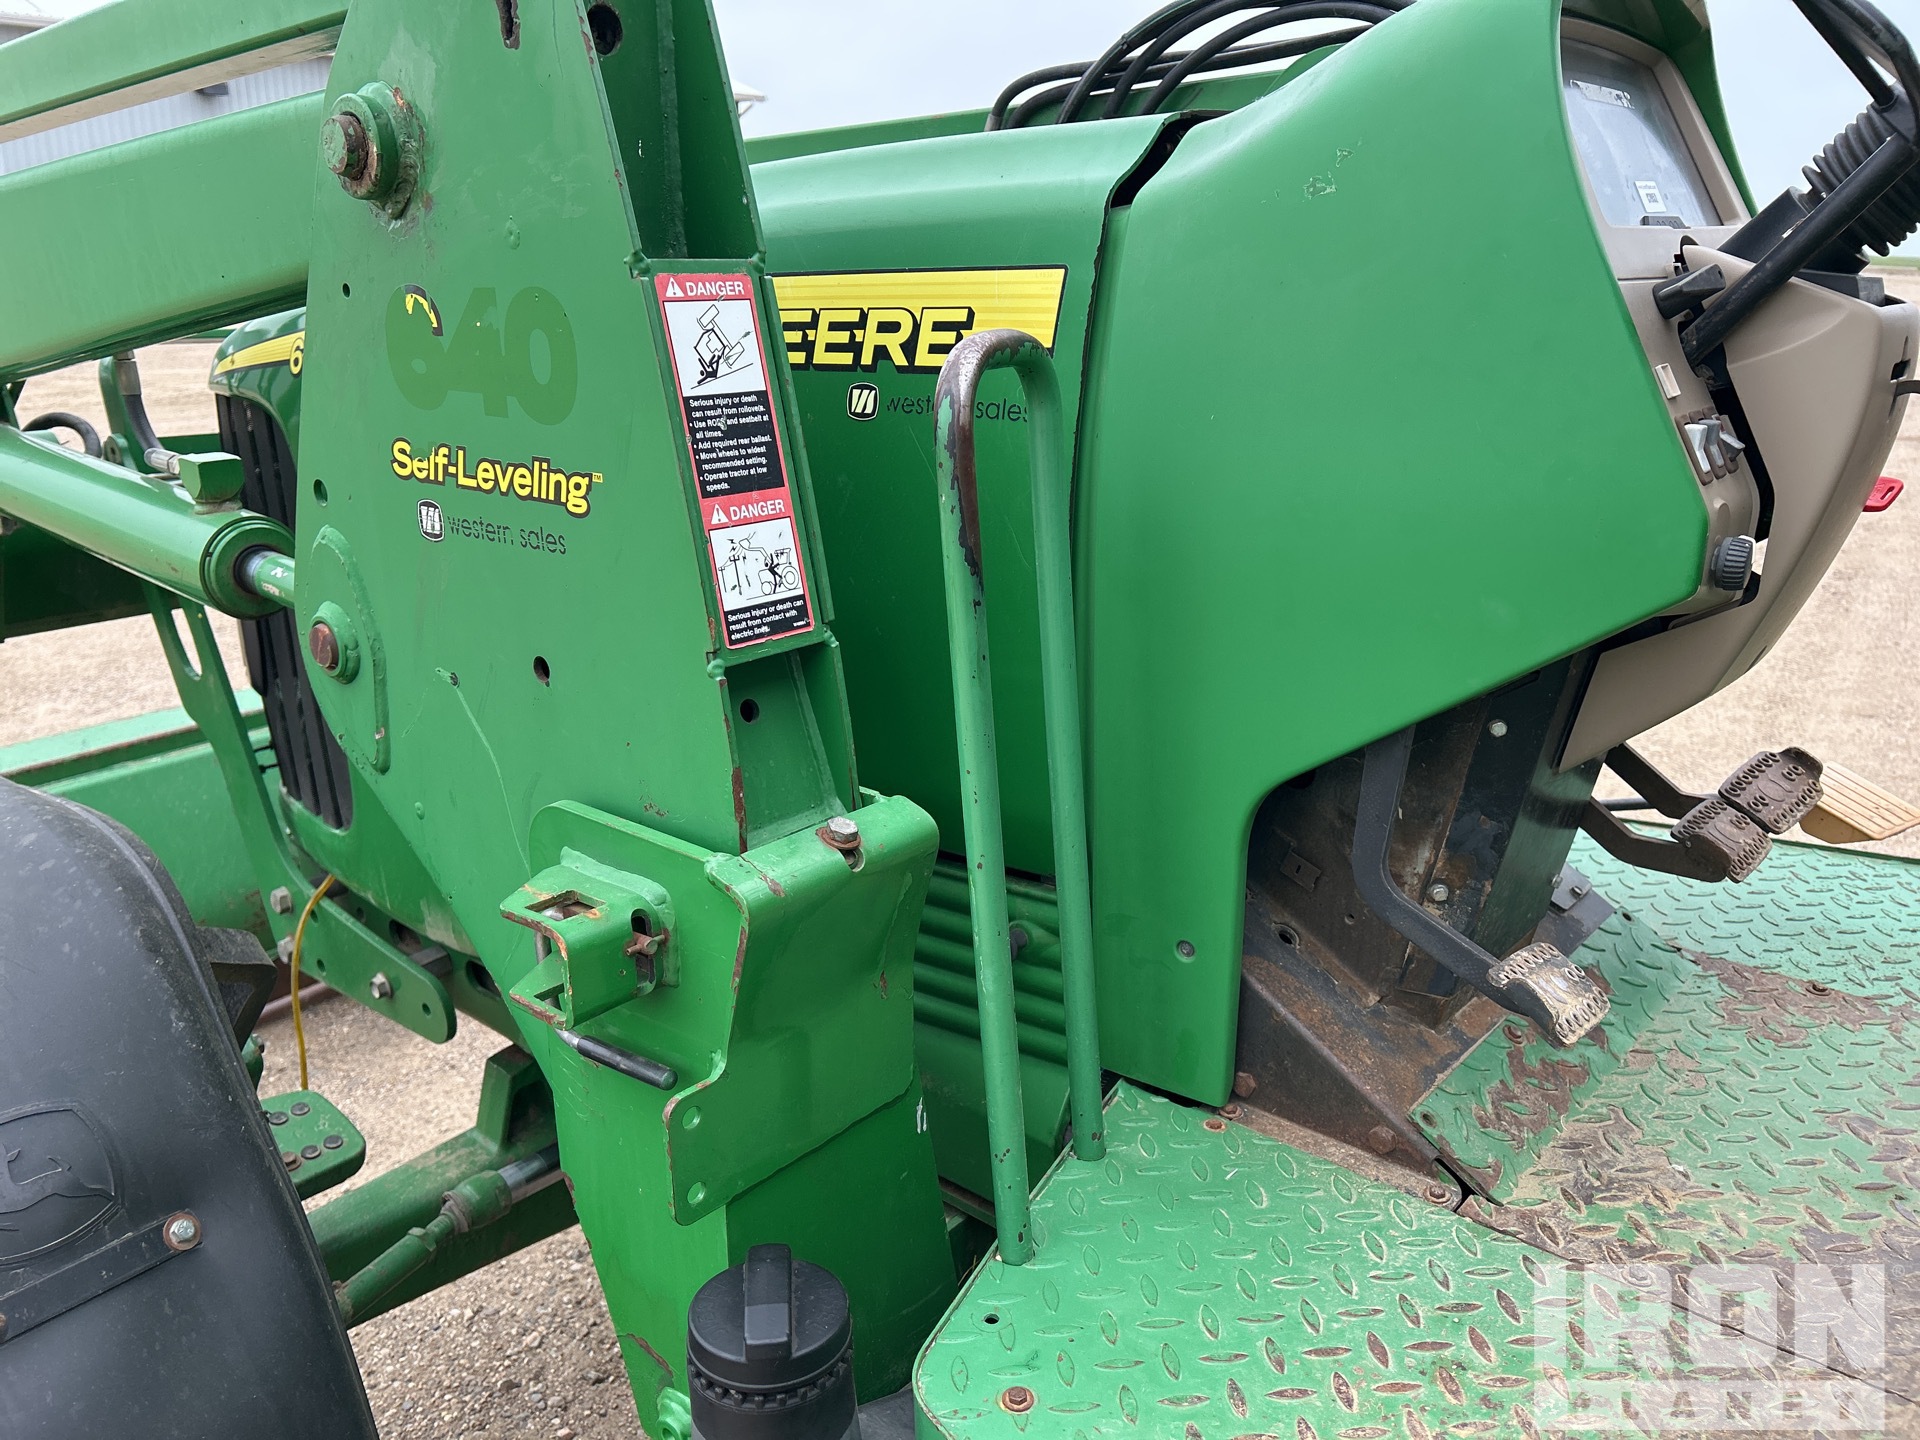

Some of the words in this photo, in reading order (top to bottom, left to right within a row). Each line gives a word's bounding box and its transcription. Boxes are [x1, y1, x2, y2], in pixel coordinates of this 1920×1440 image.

[686, 281, 744, 295] DANGER
[385, 282, 578, 425] 640
[689, 399, 713, 407] Serious
[715, 396, 731, 406] injury
[741, 394, 757, 402] death
[705, 408, 722, 416] result
[723, 407, 737, 415] from
[738, 404, 765, 413] rollovers.
[694, 420, 706, 428] Use
[727, 416, 738, 425] and
[739, 414, 761, 423] seatbelt
[698, 441, 711, 449] Add
[712, 438, 737, 448] required
[751, 434, 772, 442] ballast.
[700, 452, 716, 460] Move
[718, 449, 739, 457] wheels
[747, 445, 766, 453] widest
[702, 458, 744, 470] recommended
[391, 439, 591, 515] Self-Leveling
[704, 471, 728, 481] Operate
[729, 468, 748, 477] tractor
[757, 466, 767, 474] low
[706, 482, 730, 492] speeds.
[730, 499, 785, 520] DANGER
[447, 515, 514, 545] western
[519, 526, 566, 555] sales
[728, 611, 751, 621] Serious
[751, 607, 767, 616] injury
[776, 600, 792, 610] death
[730, 621, 747, 631] result
[747, 618, 761, 626] from
[762, 613, 784, 622] contact
[785, 609, 797, 617] with
[731, 629, 753, 640] electric
